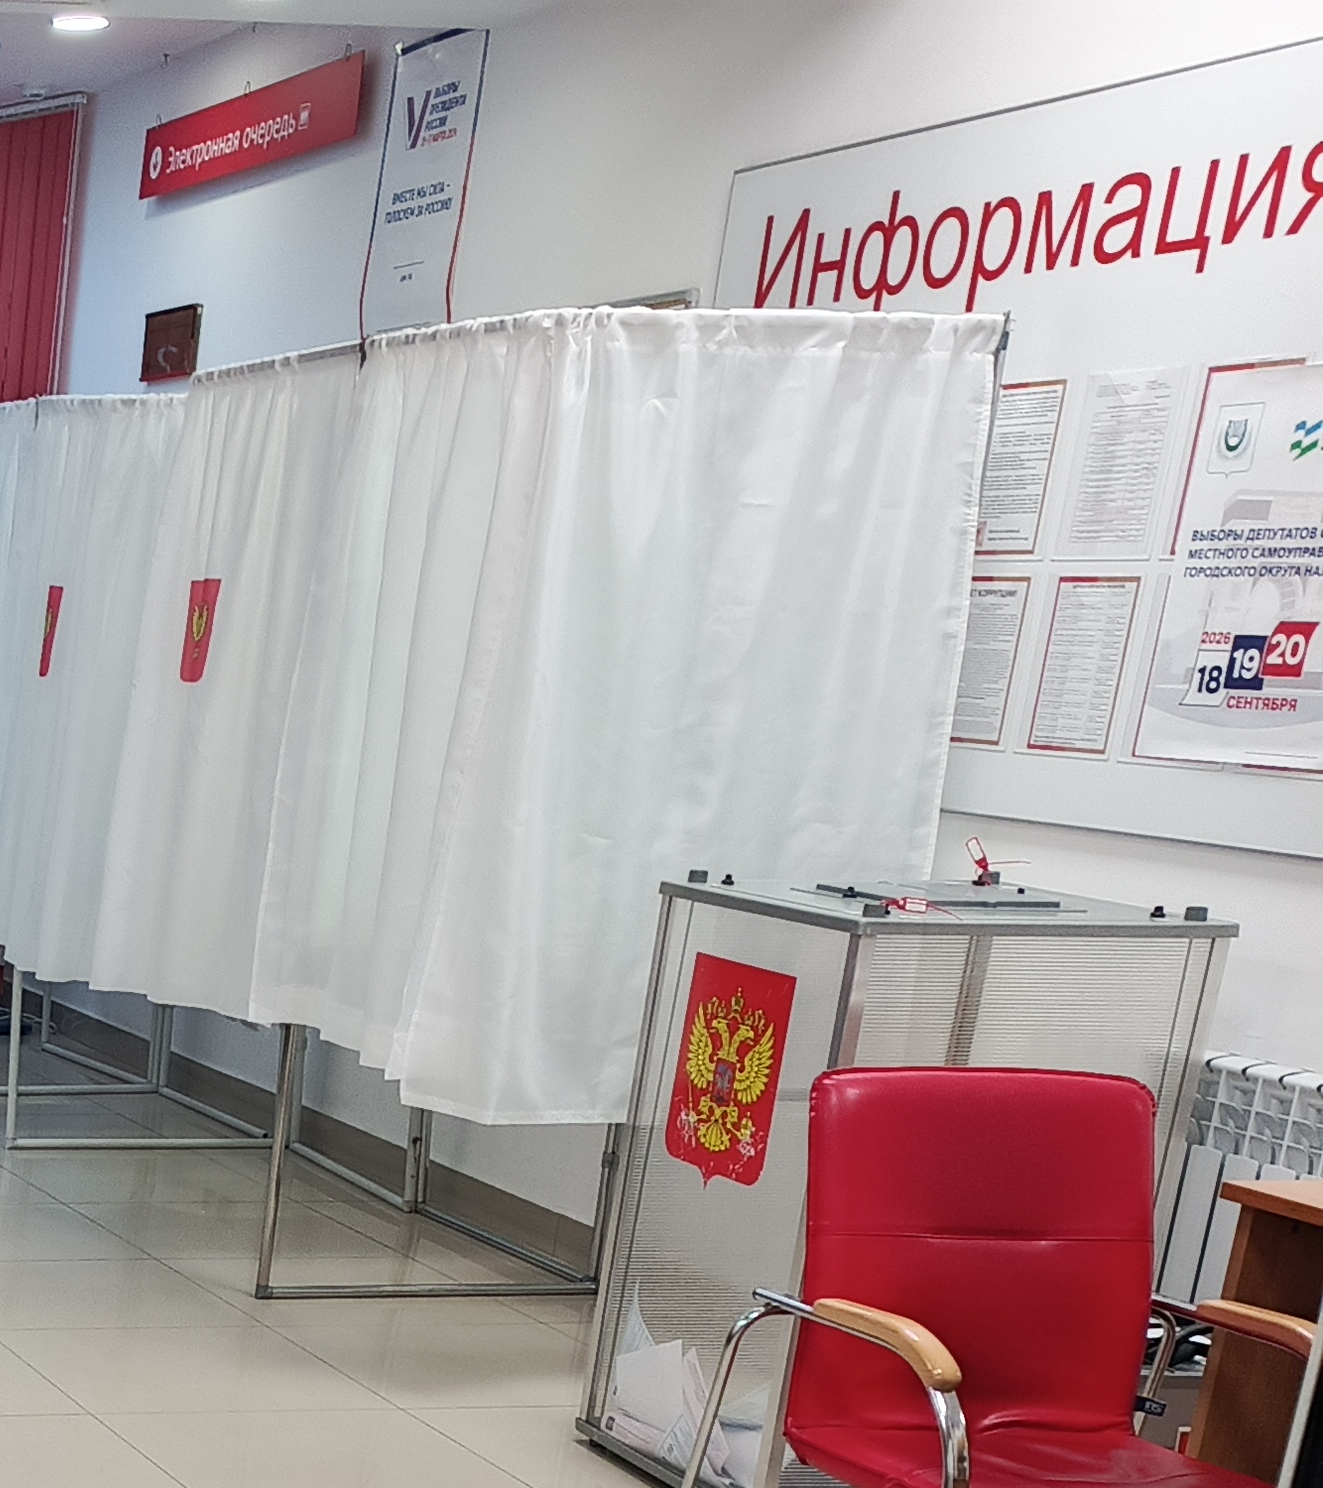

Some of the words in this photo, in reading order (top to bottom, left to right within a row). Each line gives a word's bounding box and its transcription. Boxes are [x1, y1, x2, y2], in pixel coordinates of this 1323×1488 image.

[166, 130, 240, 174] Электронная
[242, 112, 296, 149] очередь
[1191, 528, 1244, 543] ВЫБОРЫ
[1244, 526, 1318, 544] ДЕПУТАТОВ
[1187, 546, 1250, 560] МЕСТНОГО
[1183, 564, 1257, 580] ГОРОДСКОГО
[1258, 564, 1302, 579] ОКРУГА
[1303, 564, 1323, 578] НА
[1200, 631, 1232, 645] 2026
[1197, 664, 1223, 694] 18
[1232, 648, 1261, 679] 19
[1265, 633, 1306, 666] 20
[1226, 695, 1298, 712] СЕНТЯБРЯ
